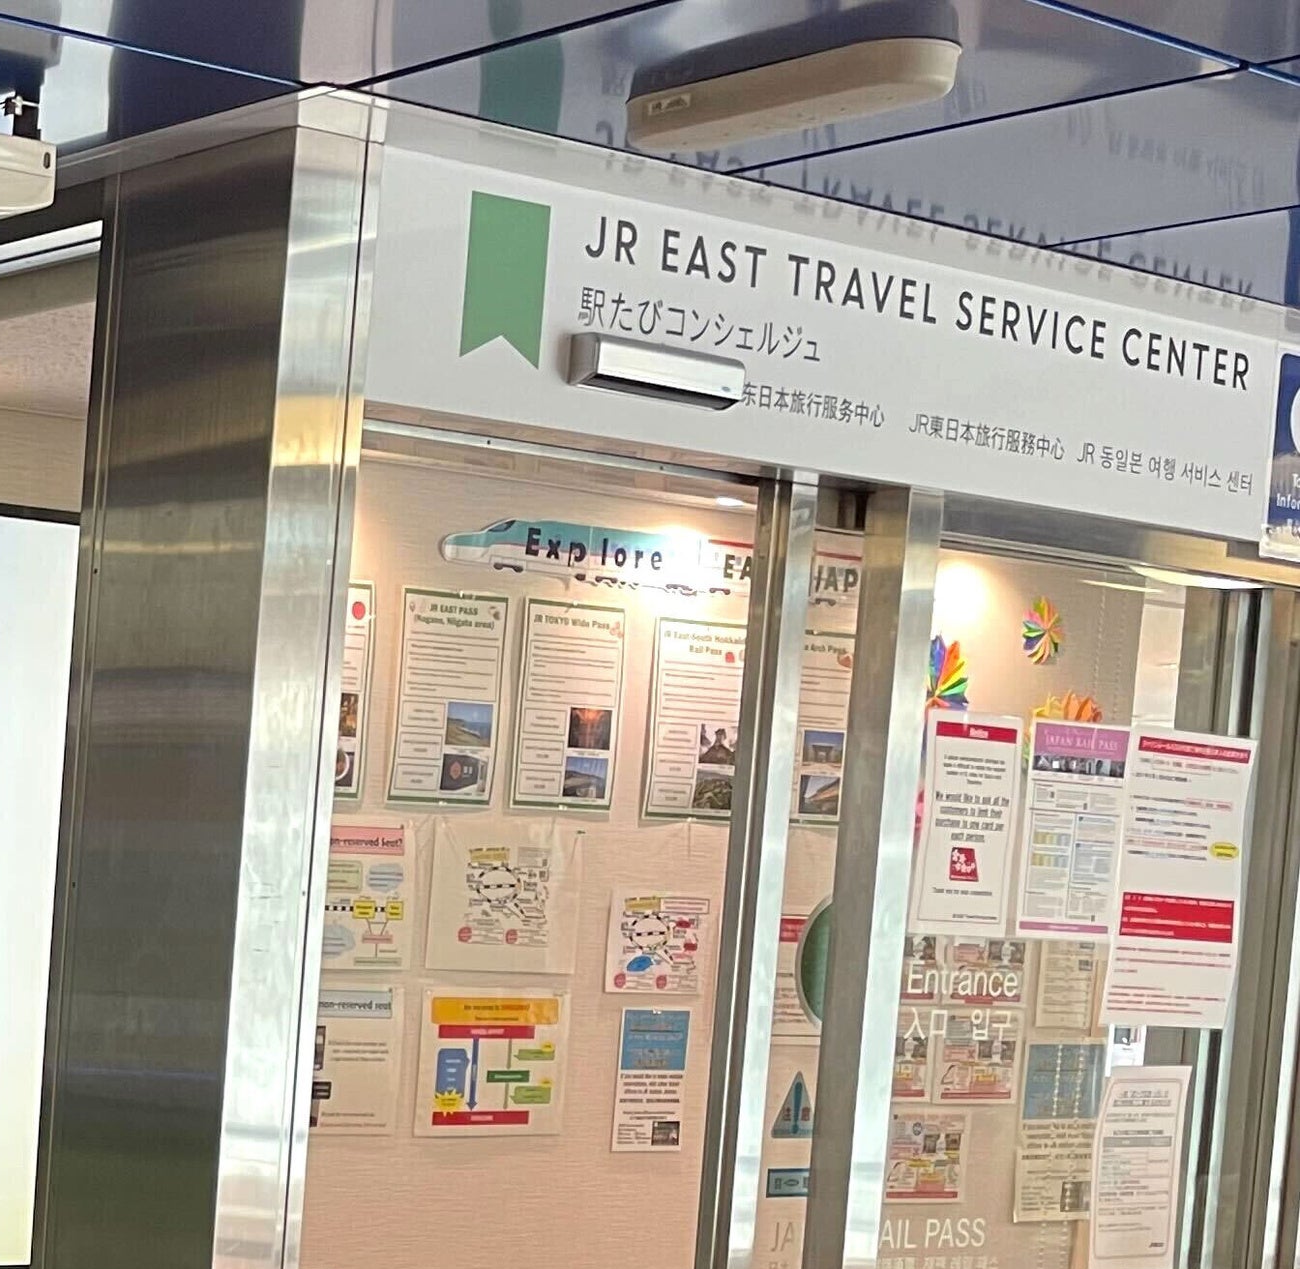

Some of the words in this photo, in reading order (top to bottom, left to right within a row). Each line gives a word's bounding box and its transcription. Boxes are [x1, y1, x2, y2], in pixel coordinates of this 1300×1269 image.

[578, 286, 820, 362] 駅たびコンシェルジュ
[585, 216, 638, 266] JR
[661, 229, 767, 288] EAST
[788, 254, 937, 325] TRAVEL
[956, 291, 1106, 360] SERVICE
[1122, 328, 1249, 390] CENTER
[908, 413, 1066, 461] JR東日本旅行服務中心
[1077, 442, 1096, 465] JR
[1100, 445, 1143, 475] 동일본
[1149, 456, 1177, 481] 여행
[1180, 461, 1222, 489] 서비스
[1226, 471, 1253, 496] 센터
[907, 965, 1020, 1000] Entrance
[904, 1009, 947, 1041] 入口
[971, 1008, 1013, 1042] 입구
[878, 1218, 917, 1250] AIL
[924, 1217, 987, 1249] PASS
